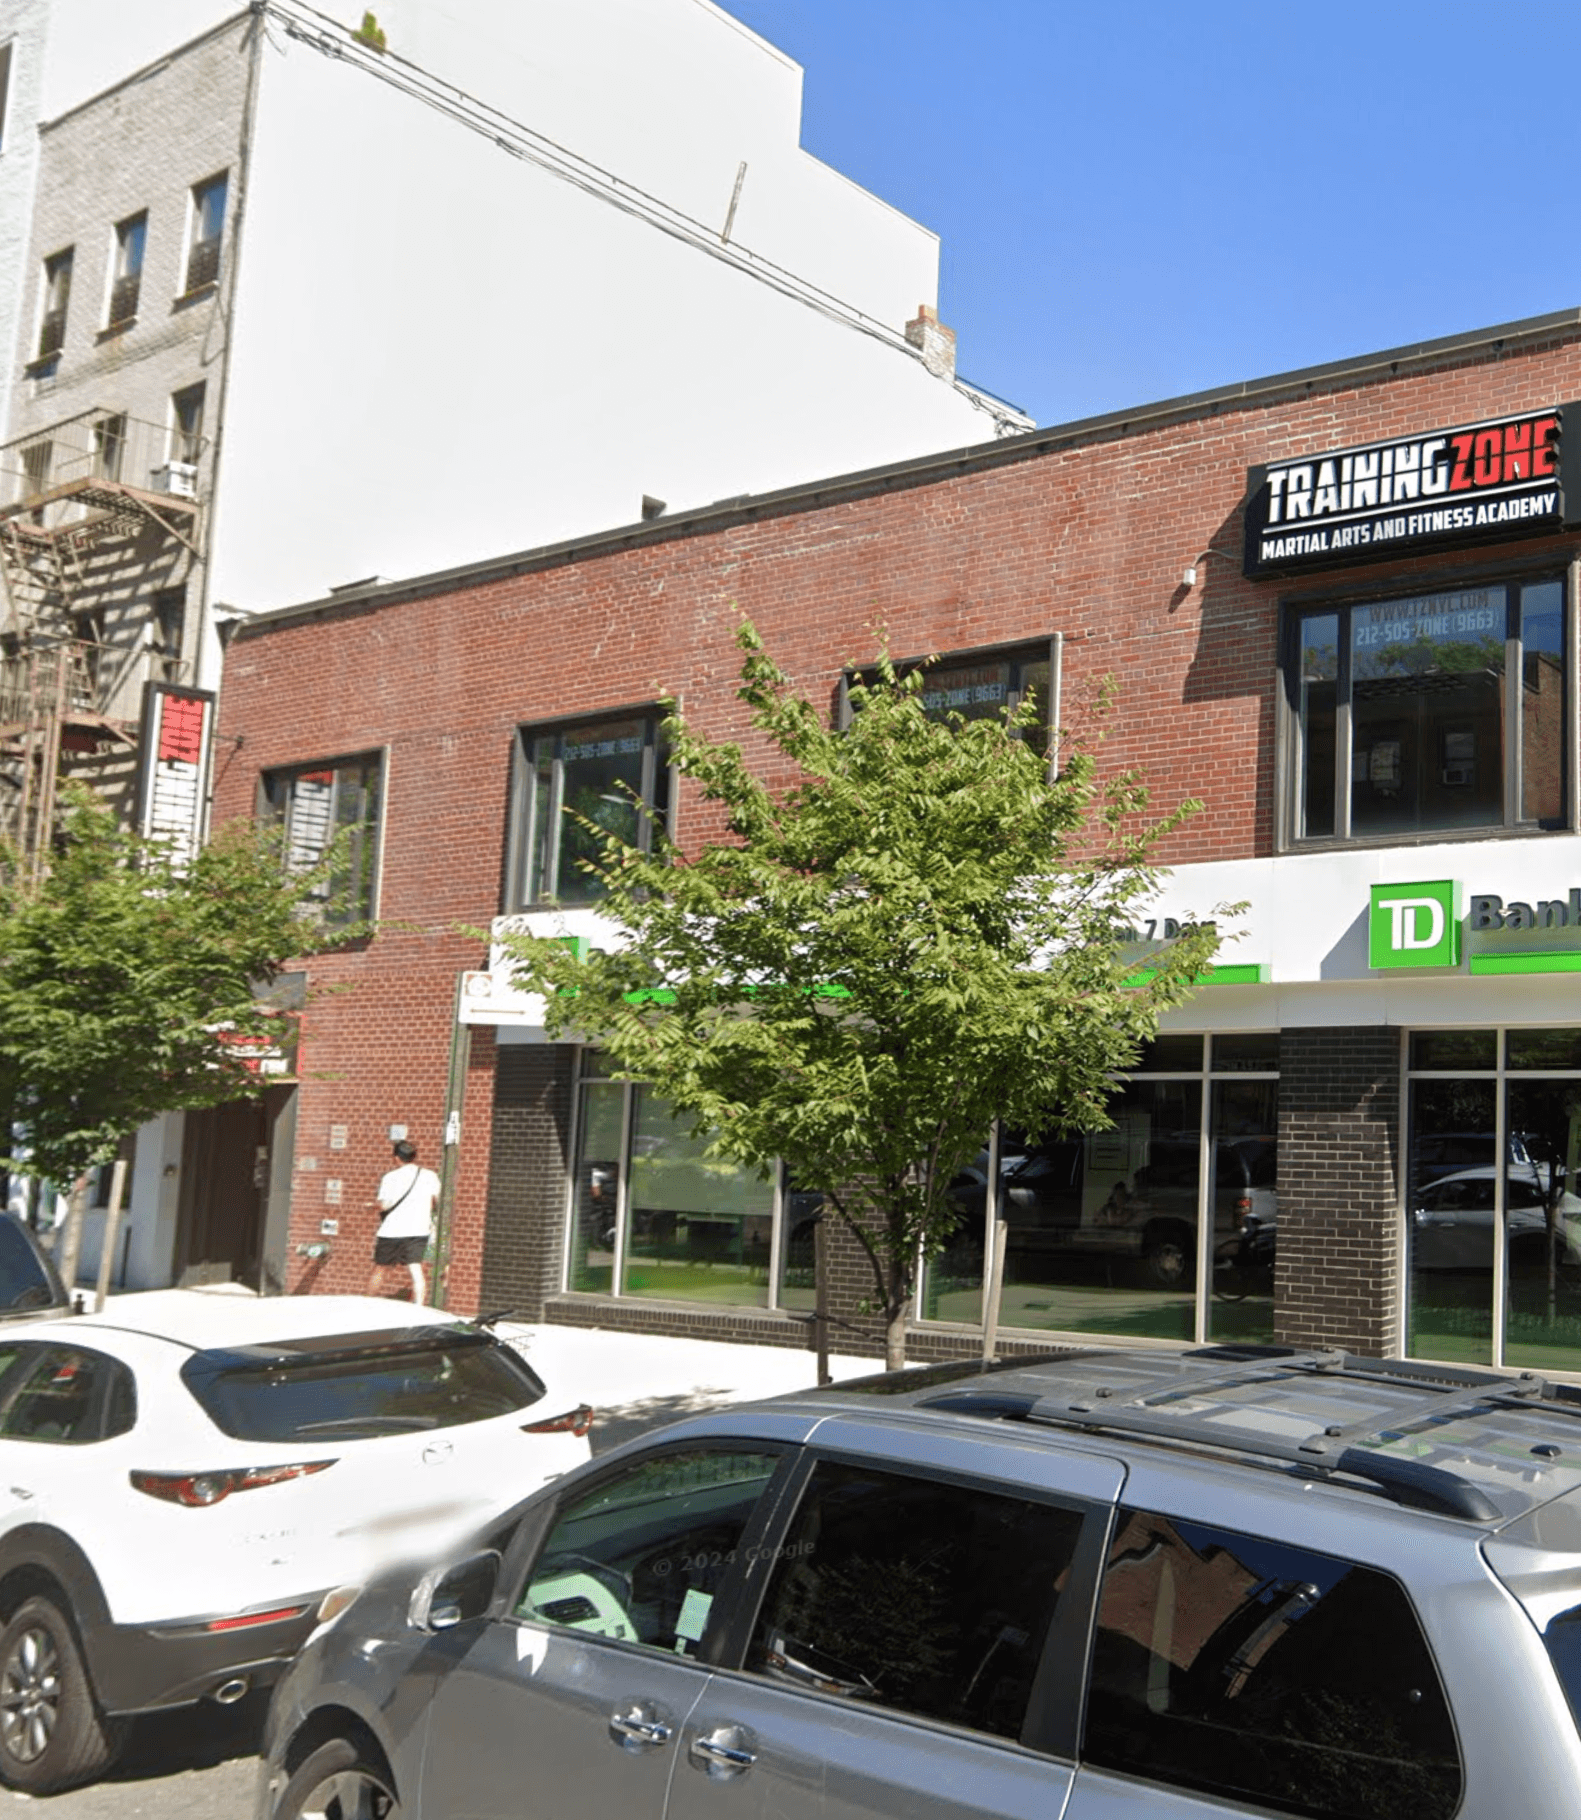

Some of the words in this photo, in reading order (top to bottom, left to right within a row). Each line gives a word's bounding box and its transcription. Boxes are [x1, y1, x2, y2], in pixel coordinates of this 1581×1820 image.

[1261, 531, 1328, 561] MARTIAL
[1331, 522, 1371, 549] ARTS
[1373, 516, 1405, 541] AND
[1408, 504, 1474, 535] FITNESS
[1475, 492, 1557, 525] ACADEMY
[1143, 918, 1158, 941] 7
[1378, 896, 1445, 950] TD
